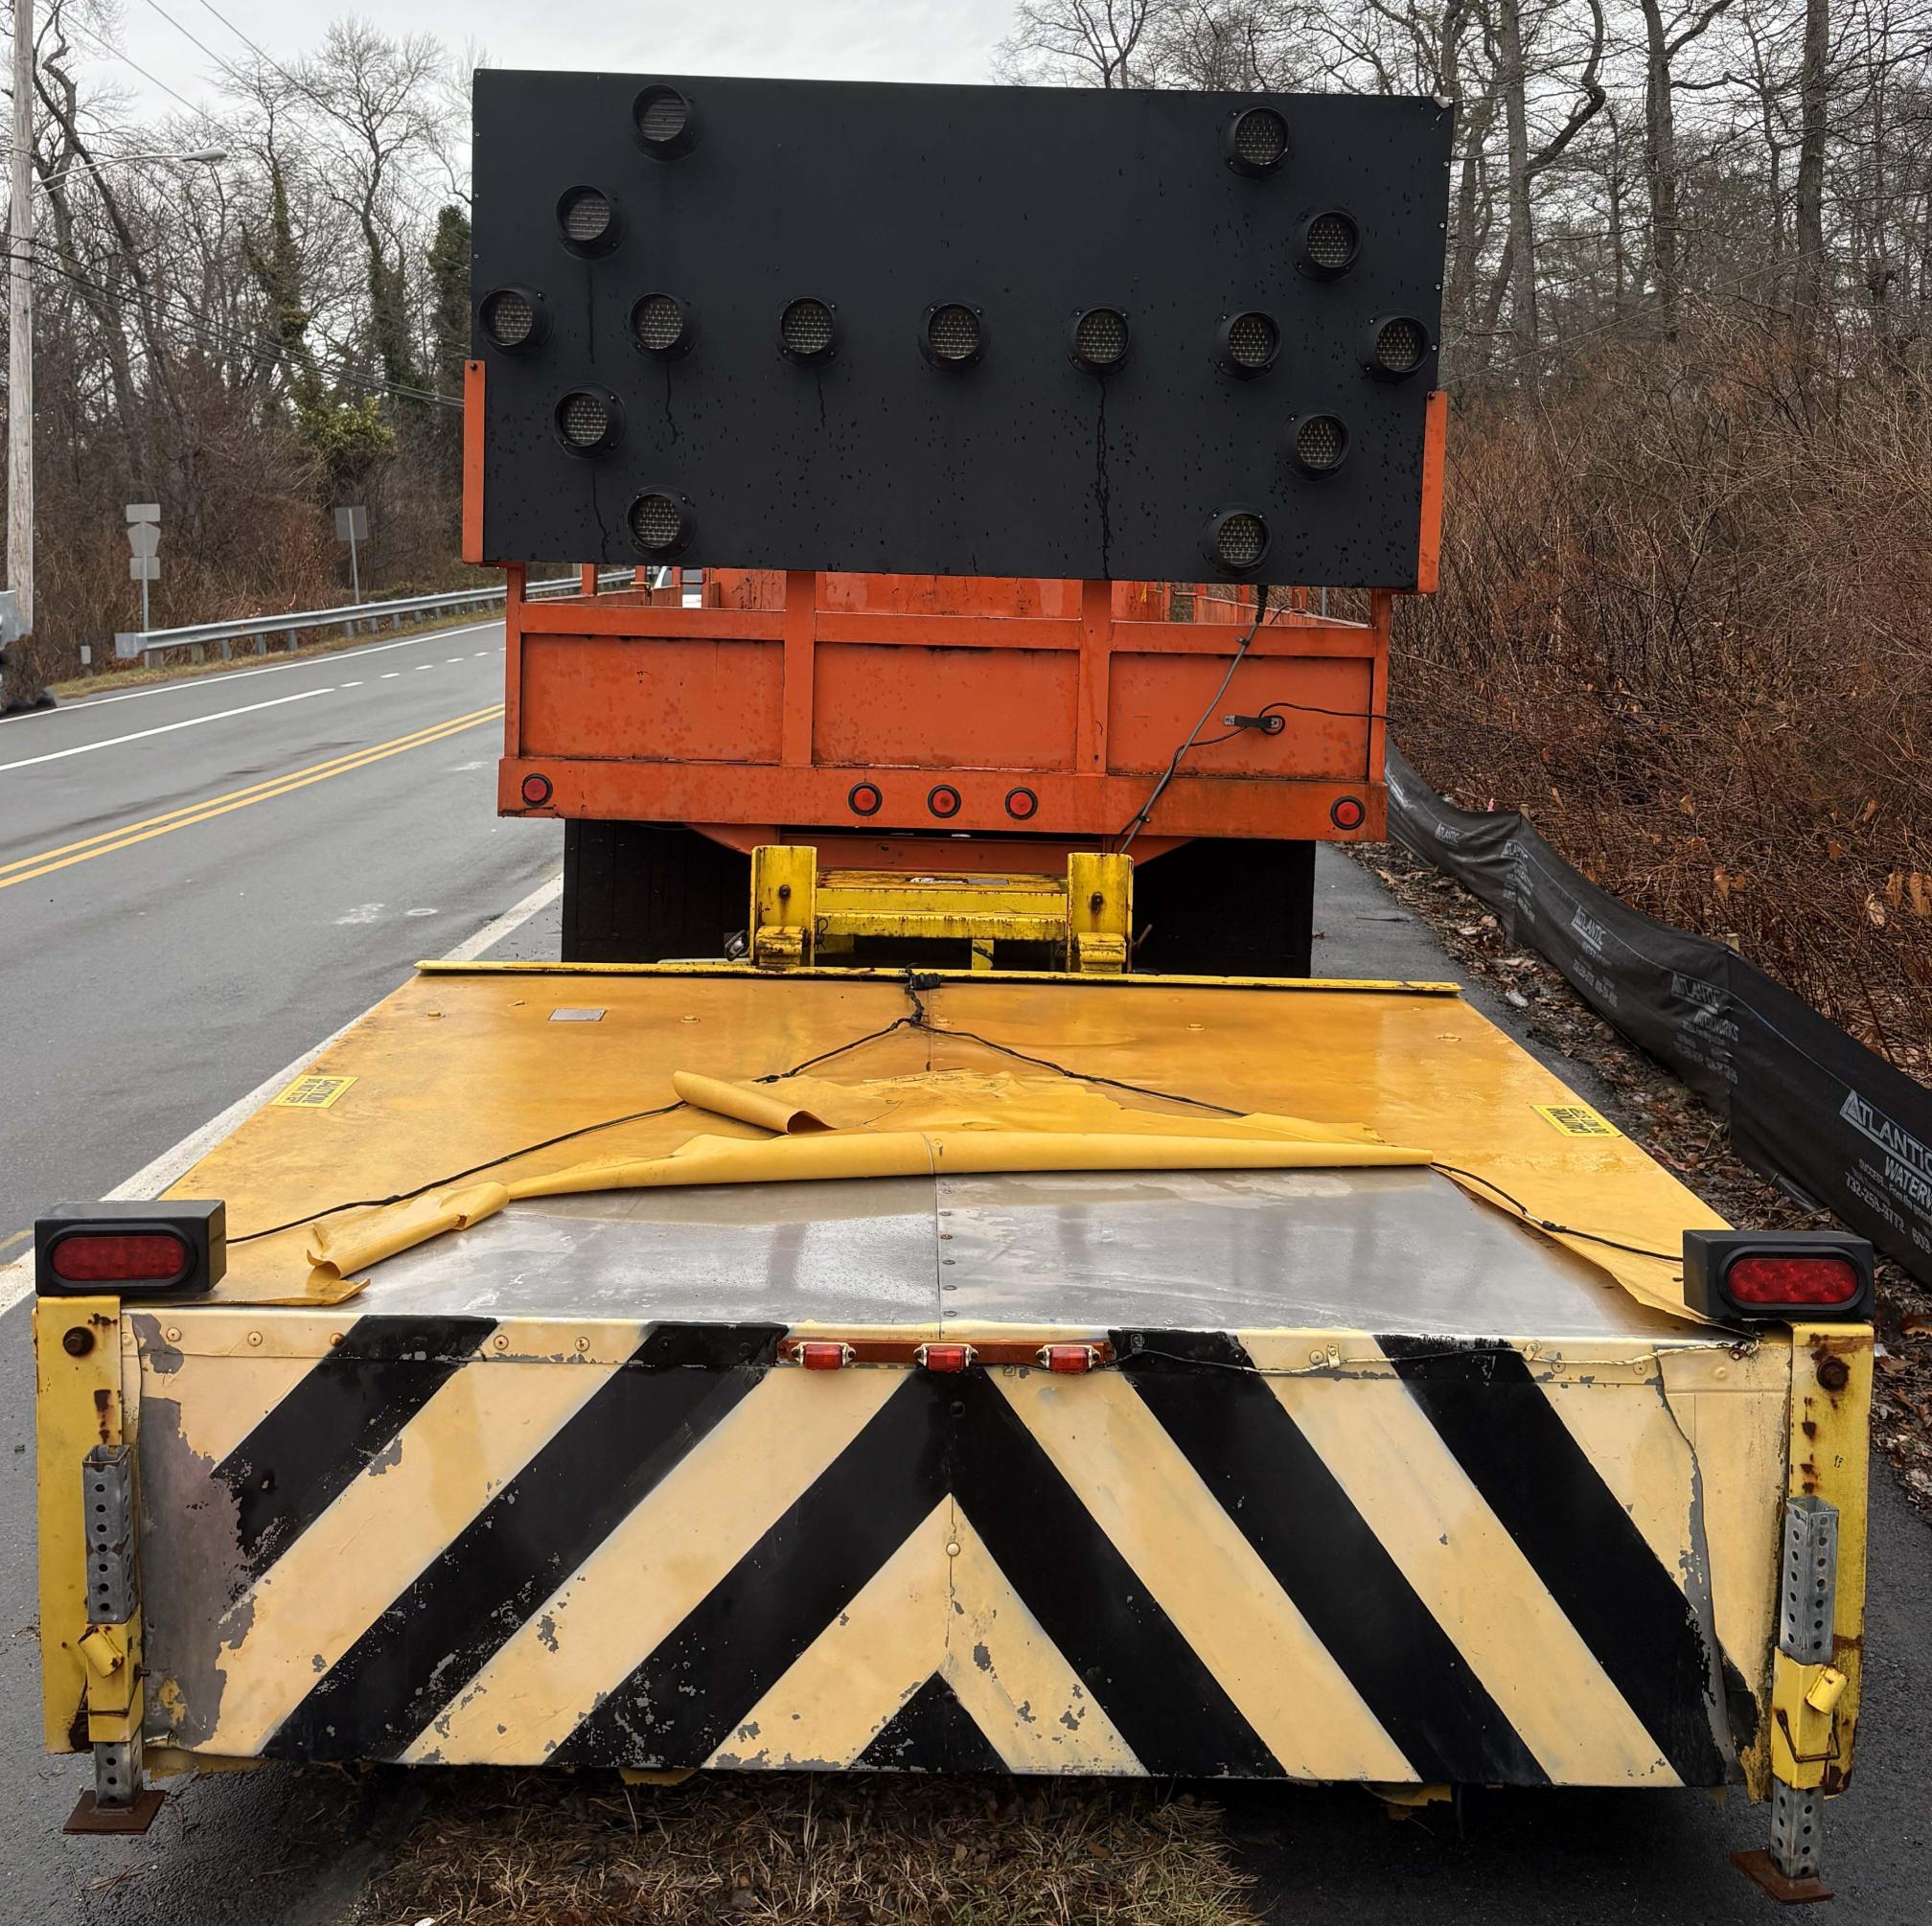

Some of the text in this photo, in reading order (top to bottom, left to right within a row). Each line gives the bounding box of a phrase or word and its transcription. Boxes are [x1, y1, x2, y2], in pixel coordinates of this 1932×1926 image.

[1572, 906, 1606, 947] ATLANTIC
[1546, 1108, 1591, 1133] CAUTION
[1840, 1089, 1932, 1175] ATLANTIC
